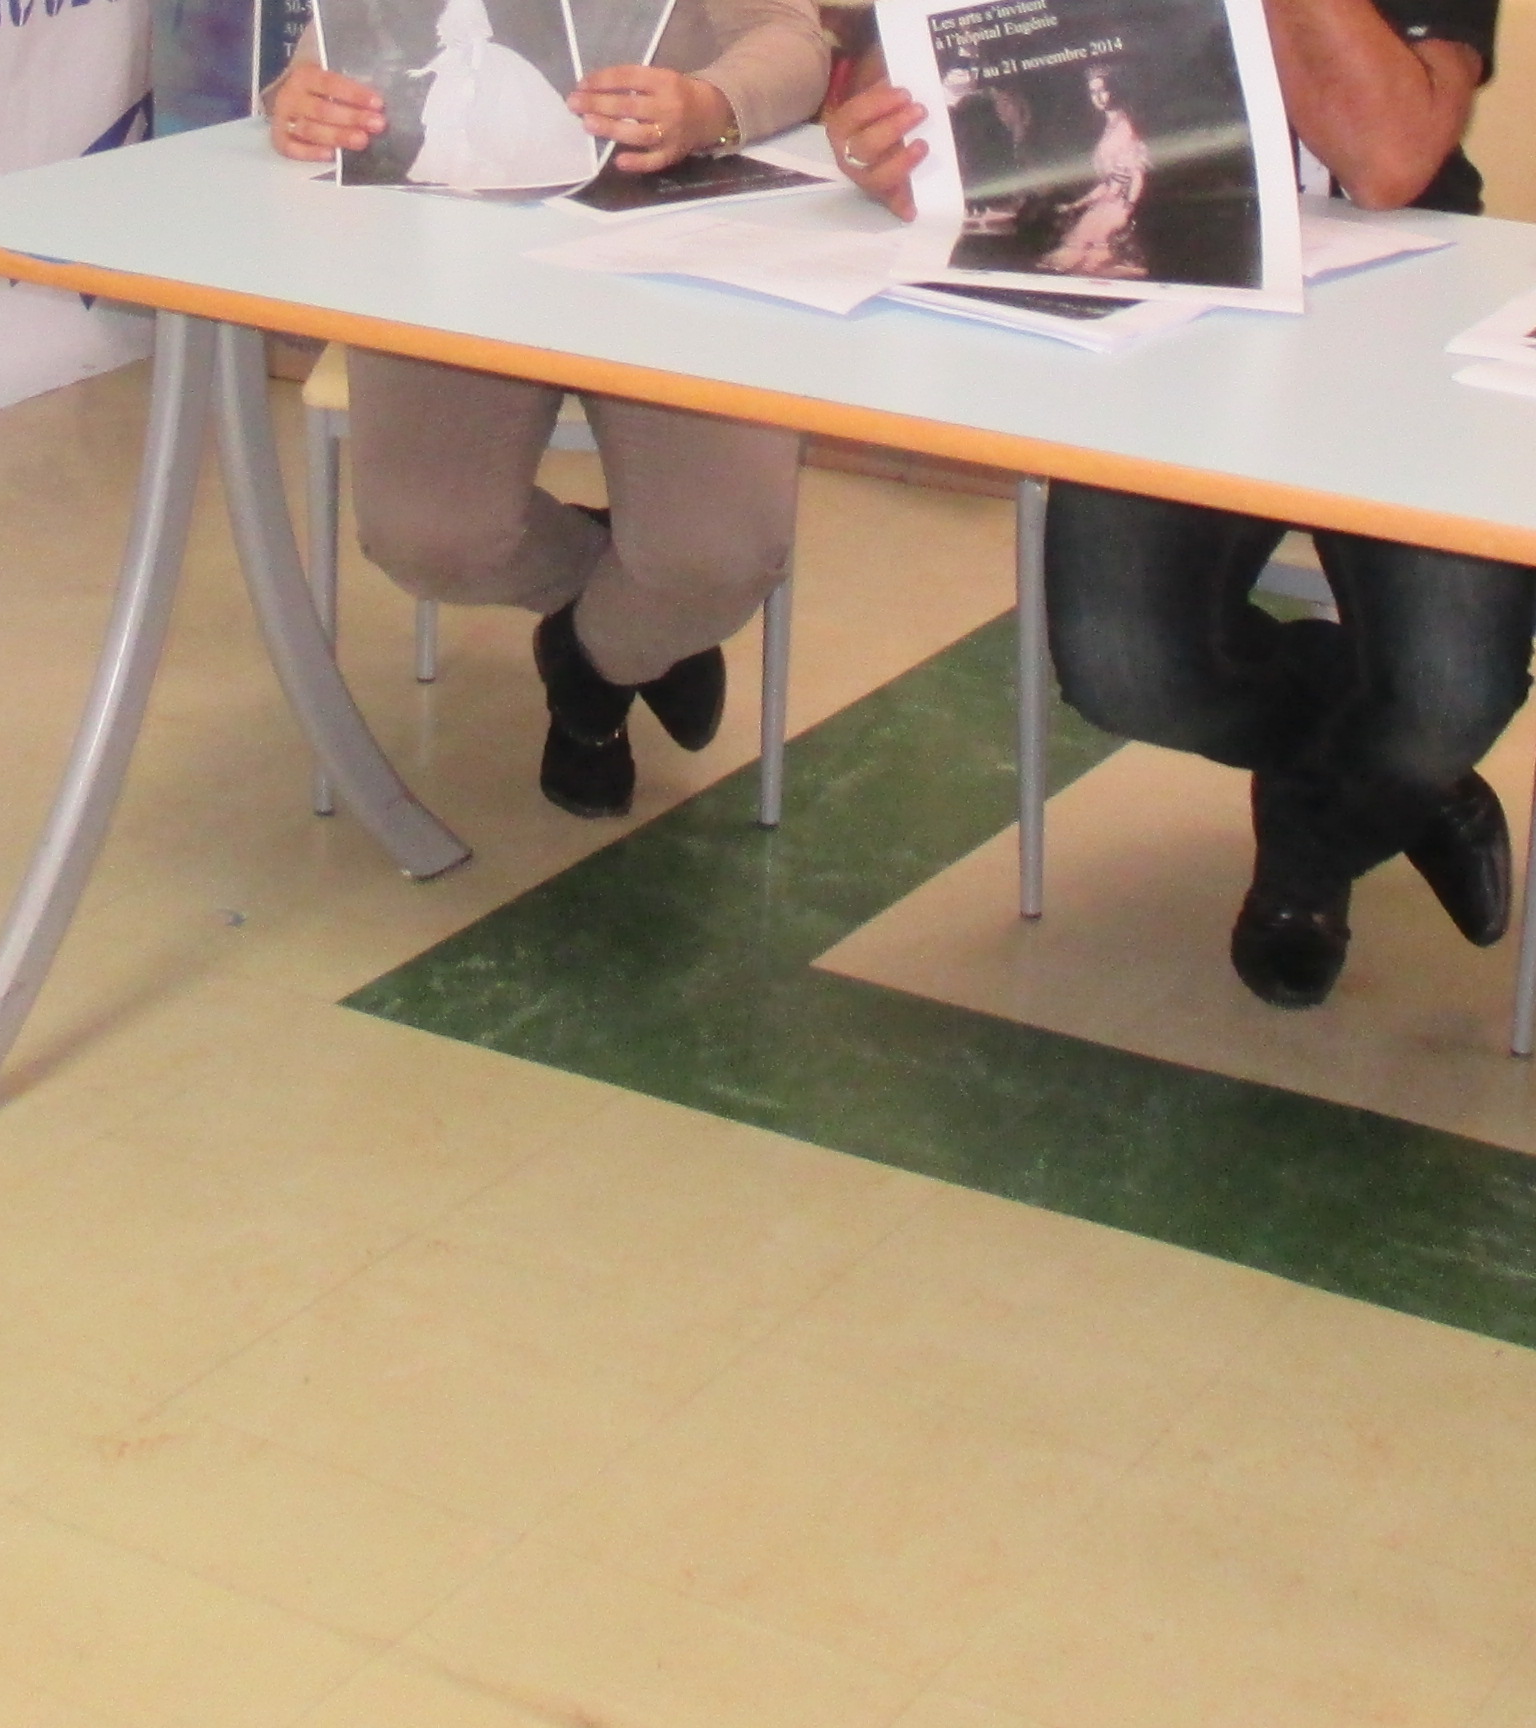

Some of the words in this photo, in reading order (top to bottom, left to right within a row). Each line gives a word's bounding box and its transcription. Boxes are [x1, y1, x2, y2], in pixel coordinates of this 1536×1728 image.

[932, 17, 955, 32] Les
[958, 13, 982, 27] arts
[1005, 15, 1058, 35] Eugénie
[983, 65, 999, 79] au
[1001, 59, 1018, 74] 21
[1021, 45, 1088, 71] novembre
[1089, 37, 1123, 57] 2014
